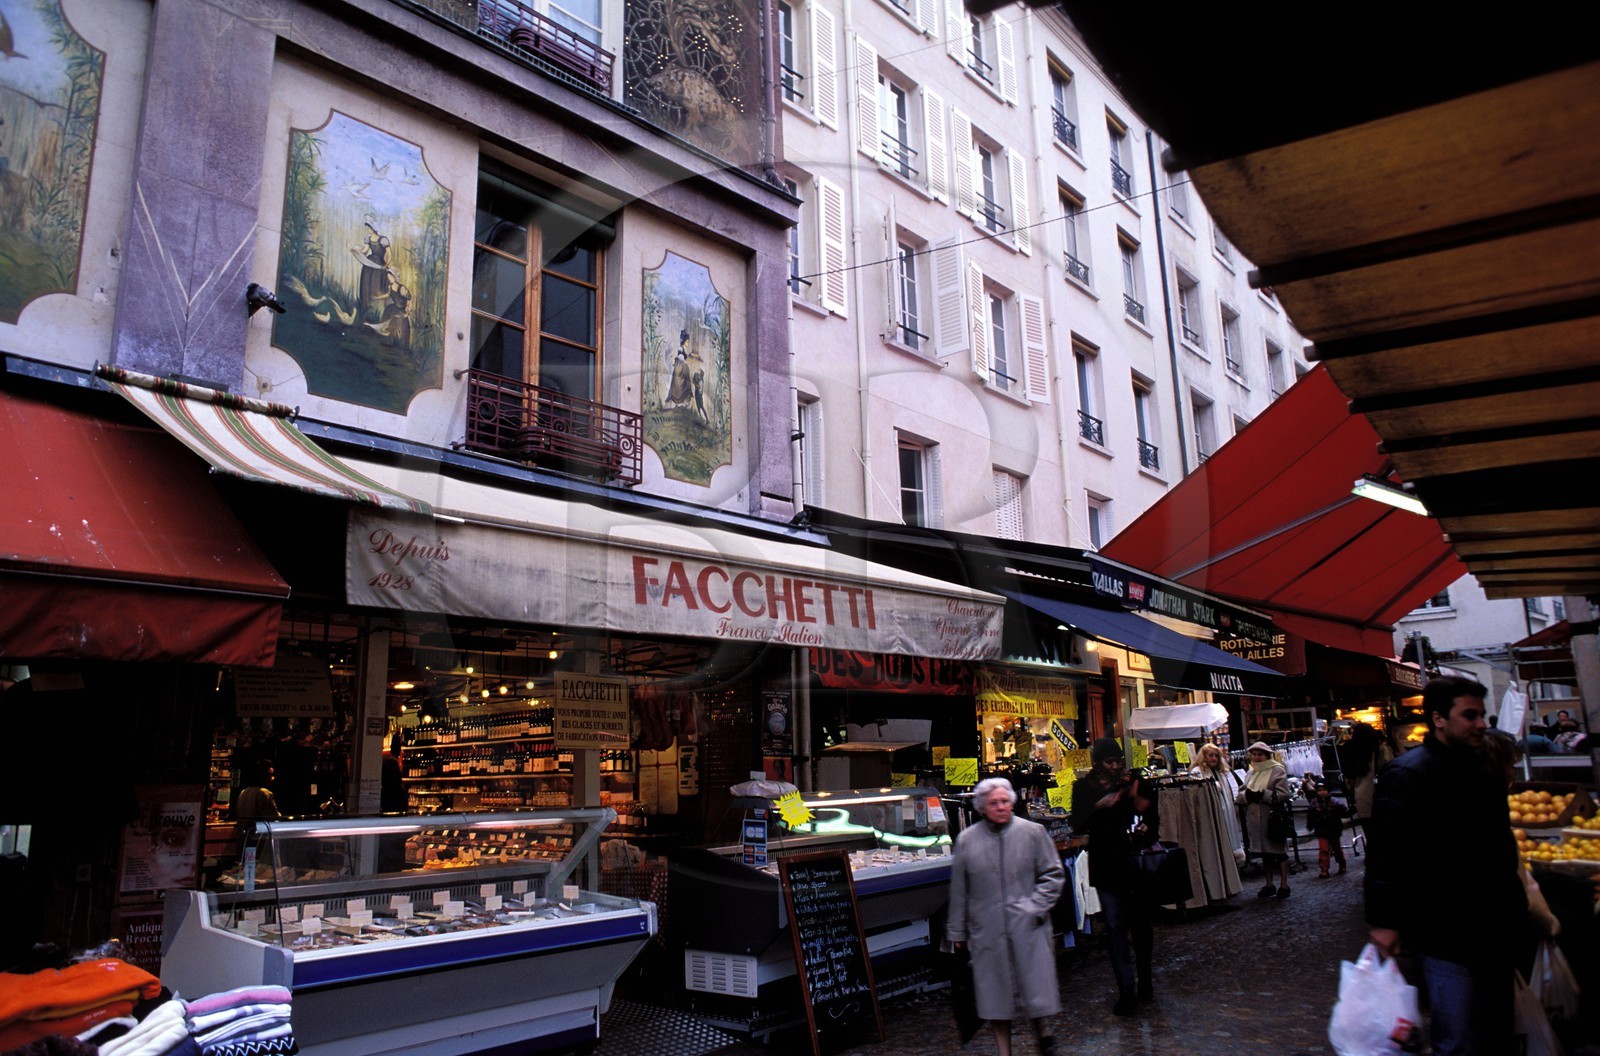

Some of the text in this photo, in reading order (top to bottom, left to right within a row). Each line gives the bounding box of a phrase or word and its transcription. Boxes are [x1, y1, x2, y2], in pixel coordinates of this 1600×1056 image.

[368, 528, 450, 566] Depuis
[367, 572, 415, 591] 1928
[631, 555, 876, 630] FACCHETTI
[1091, 570, 1124, 598] DALLAS
[1149, 588, 1187, 618] JONATHAN
[1192, 602, 1216, 626] STARK
[716, 616, 823, 645] Franco Italien
[1220, 634, 1286, 651] ROTISSRIE
[1230, 646, 1285, 661] OLAILLES
[873, 652, 975, 685] MONSTRES
[561, 679, 622, 702] FACCHETTI
[1209, 671, 1245, 692] NIKITA
[557, 708, 570, 717] VOUS
[571, 708, 591, 718] PROPOSE
[592, 709, 607, 719] TOUTE
[976, 699, 988, 712] DES
[990, 699, 1019, 714] ENSEMBLES
[572, 720, 592, 729] GLACES
[593, 721, 600, 729] ET
[601, 721, 624, 731] SORBETS
[557, 732, 564, 740] DE
[565, 732, 598, 742] FABRICATION
